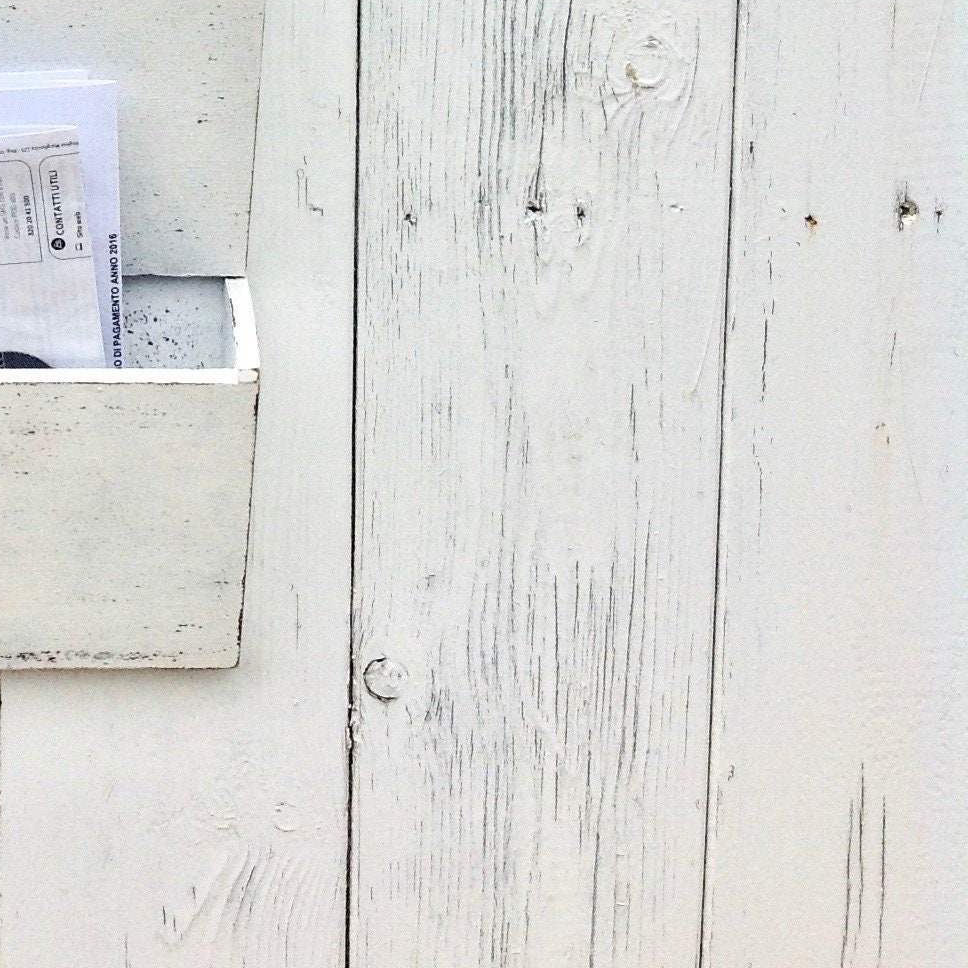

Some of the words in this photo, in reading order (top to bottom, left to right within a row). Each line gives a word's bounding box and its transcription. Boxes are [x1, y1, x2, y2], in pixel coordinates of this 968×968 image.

[48, 169, 59, 191] UTILI
[51, 192, 64, 235] CONTATTI
[108, 233, 117, 254] 2016
[109, 256, 118, 284] ANNO
[110, 286, 121, 345] PAGAMENTO
[113, 348, 121, 357] DI
